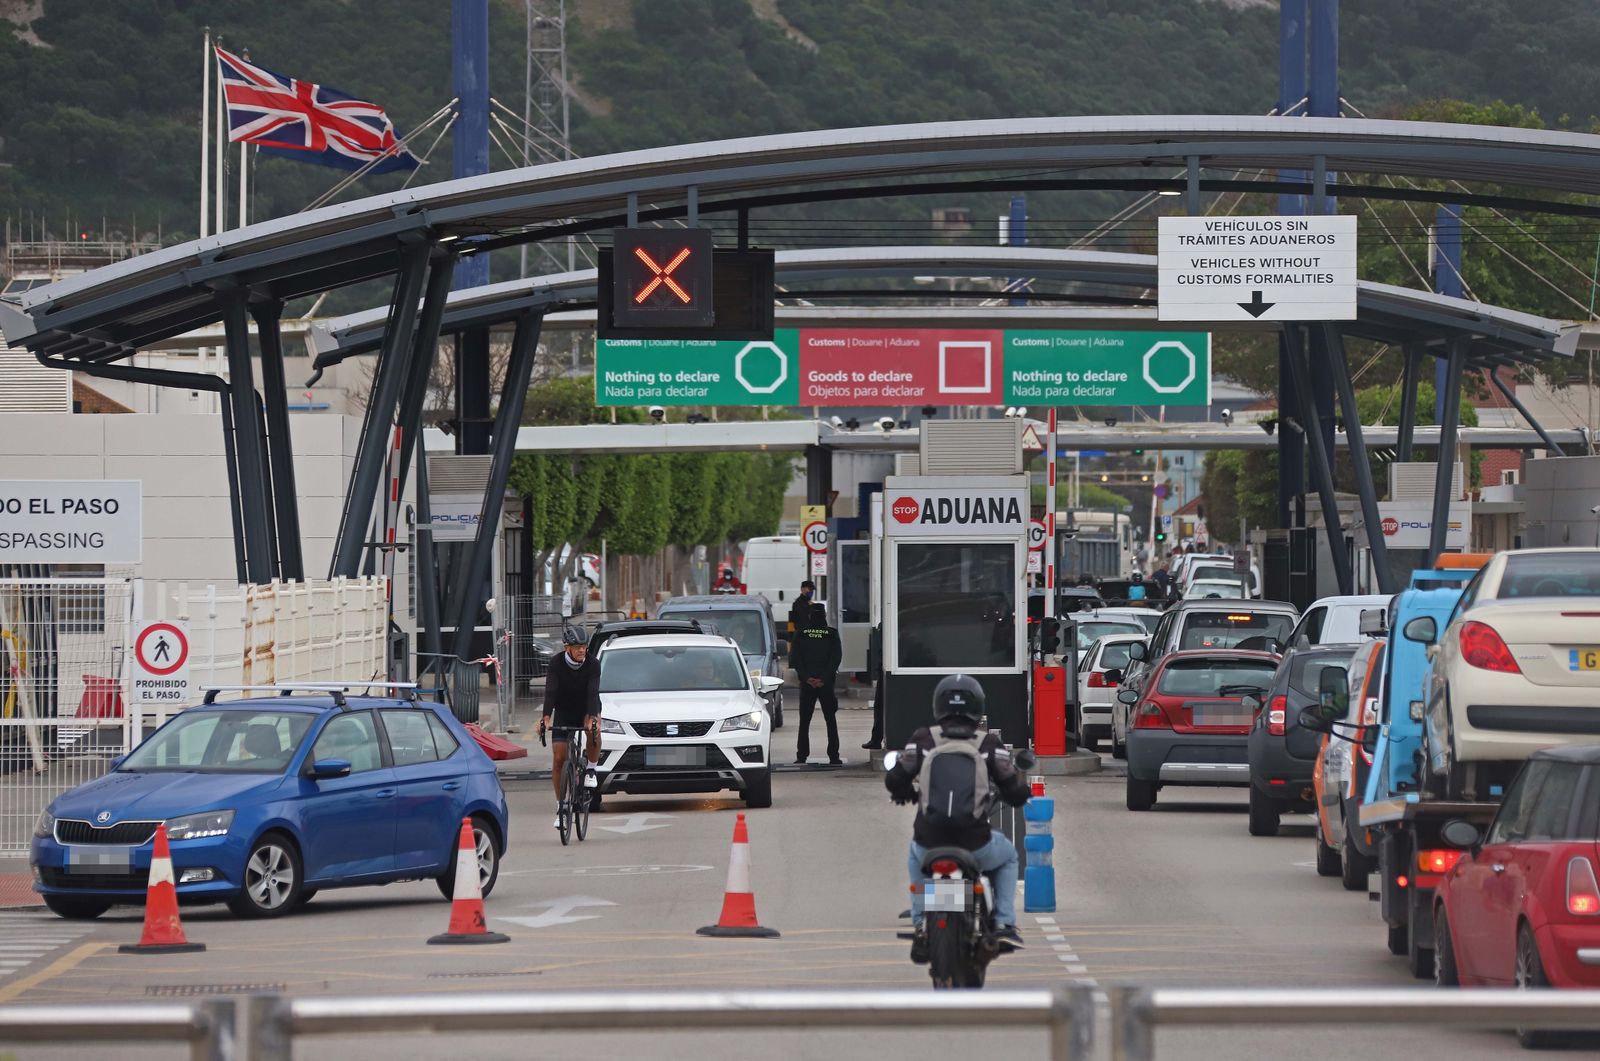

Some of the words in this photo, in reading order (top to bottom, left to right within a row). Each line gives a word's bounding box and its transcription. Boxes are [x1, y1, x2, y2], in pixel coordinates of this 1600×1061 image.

[1205, 219, 1282, 232] VEHÍCULOS
[1286, 221, 1308, 231] SIN
[1178, 233, 1246, 246] TRÁMITES
[1250, 234, 1336, 245] ADUANEROS
[1191, 258, 1256, 268] VEHICLES
[1260, 257, 1321, 268] WITHOUT
[1177, 274, 1242, 285] CUSTOMS
[1246, 273, 1334, 284] FORMALITIES
[808, 338, 846, 347] Customs
[852, 338, 883, 347] Douane
[889, 338, 920, 347] Aduana
[1012, 338, 1050, 346] Customs
[1056, 338, 1087, 346] Douane
[1093, 338, 1124, 346] Aduana
[605, 371, 655, 385] Nothing
[659, 373, 672, 382] to
[675, 371, 720, 382] declare
[808, 370, 848, 382] Goods
[852, 373, 865, 382] to
[868, 370, 913, 382] declare
[1012, 370, 1062, 385] Nothing
[1066, 373, 1079, 382] to
[1083, 370, 1128, 382] declare
[605, 385, 635, 397] Nada
[638, 388, 662, 399] para
[665, 385, 708, 397] declarar
[808, 385, 850, 399] Objetos
[854, 387, 878, 398] para
[881, 385, 925, 397] declarar
[1012, 385, 1041, 396] Nada
[1045, 387, 1069, 398] para
[1073, 385, 1116, 396] declarar
[29, 498, 55, 514] EL
[62, 498, 119, 514] PASO
[894, 506, 917, 514] STOP
[920, 497, 1022, 524] ADUANA
[1381, 522, 1398, 531] STOP
[810, 530, 828, 544] 10
[136, 680, 187, 688] PROHIBIDO
[142, 691, 153, 699] EL
[156, 691, 181, 699] PASO
